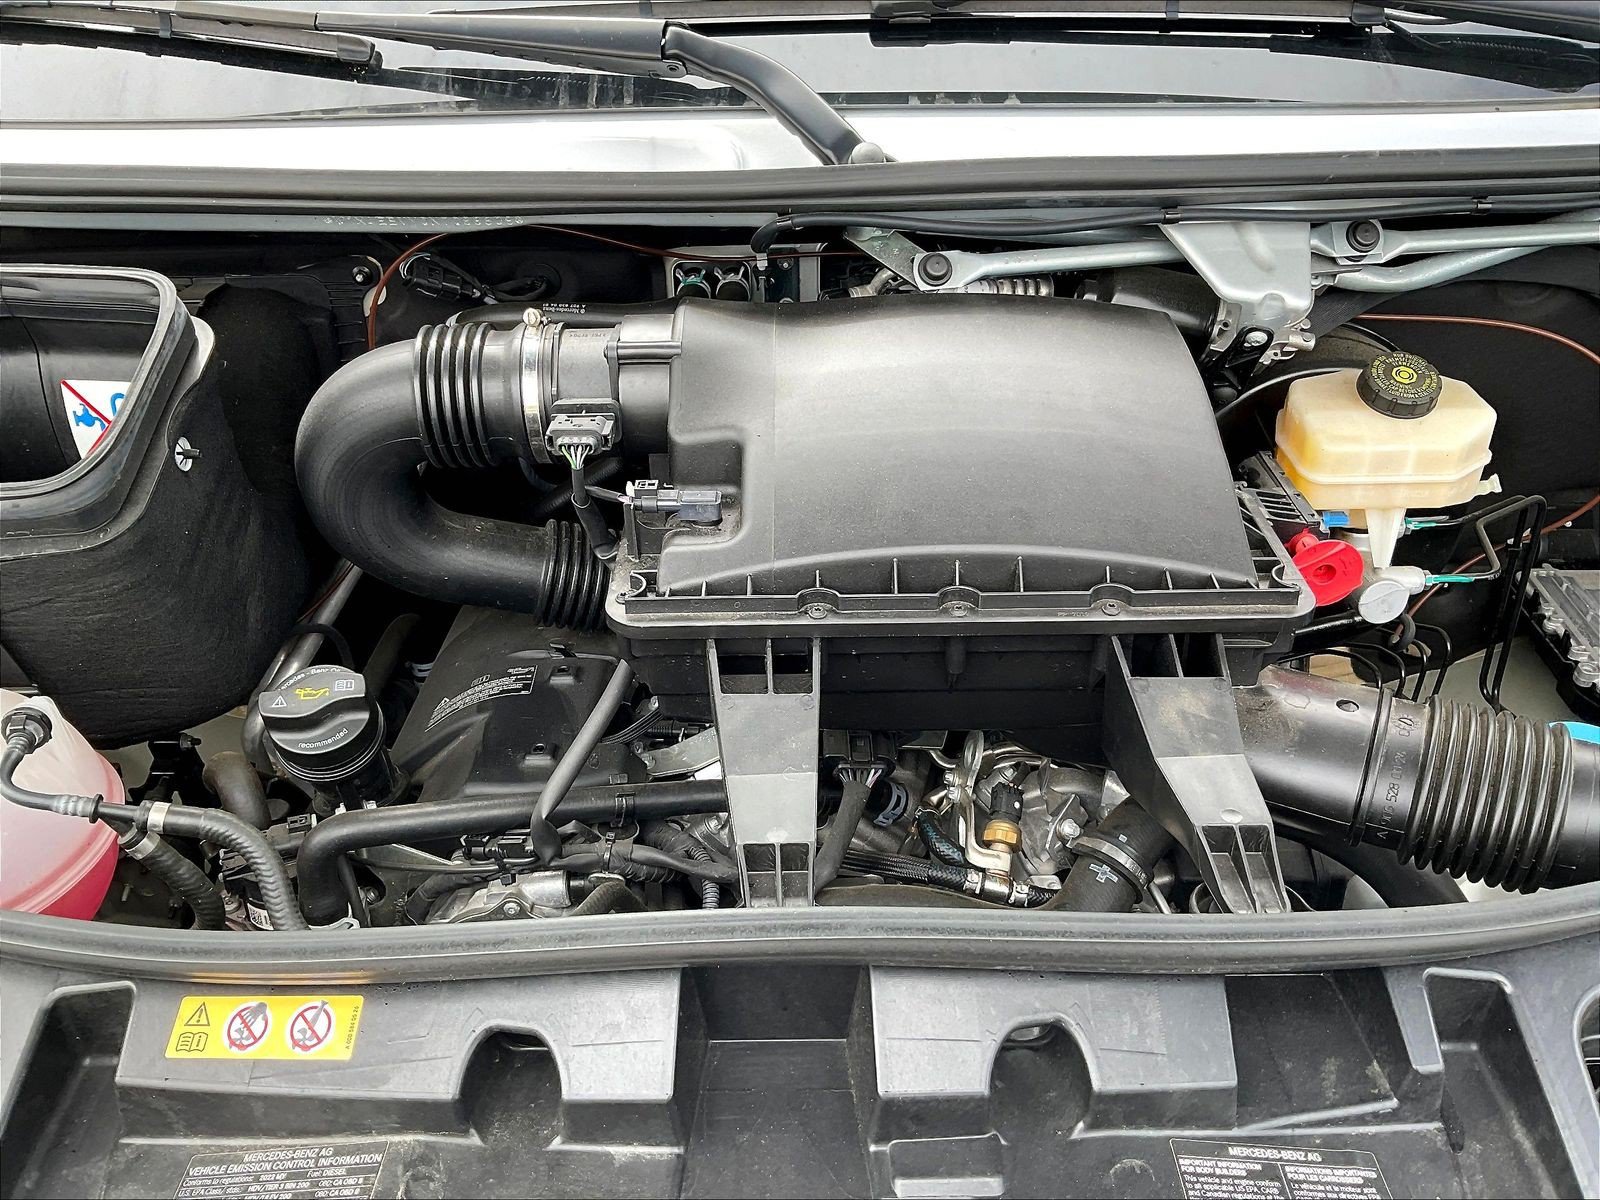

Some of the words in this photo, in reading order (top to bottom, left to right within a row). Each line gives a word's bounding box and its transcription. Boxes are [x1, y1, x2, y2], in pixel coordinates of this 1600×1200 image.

[542, 306, 580, 314] Mercedes-Benz
[278, 673, 305, 691] ercedes
[297, 728, 349, 749] recommended
[1385, 782, 1400, 802] 528
[243, 1148, 319, 1163] MERCEDES-BENZ
[319, 1147, 334, 1157] AG
[1228, 1146, 1307, 1161] MERCEDES-BENZ
[1307, 1152, 1322, 1162] AG
[188, 1164, 227, 1176] VEHICLE
[227, 1162, 272, 1174] EMISSION
[272, 1158, 315, 1170] CONTROL
[317, 1153, 382, 1167] INFORMATION
[1179, 1158, 1217, 1167] IMPORTANT
[1216, 1160, 1262, 1171] INFORMATION
[307, 1170, 322, 1178] Fuel:
[322, 1168, 347, 1177] DIESEL
[1195, 1166, 1214, 1174] BODY
[1214, 1167, 1248, 1177] BUILDERS
[1285, 1165, 1333, 1176] INFORMATIONS
[1333, 1168, 1377, 1179] IMPORTANTES
[1287, 1172, 1306, 1180] POUR
[1183, 1174, 1197, 1182] This
[1198, 1176, 1220, 1184] vehicle
[1233, 1179, 1255, 1187] engine
[191, 1189, 205, 1197] EPA
[296, 1181, 310, 1189] 200
[339, 1188, 354, 1196] OBD
[1201, 1190, 1231, 1198] Canadian
